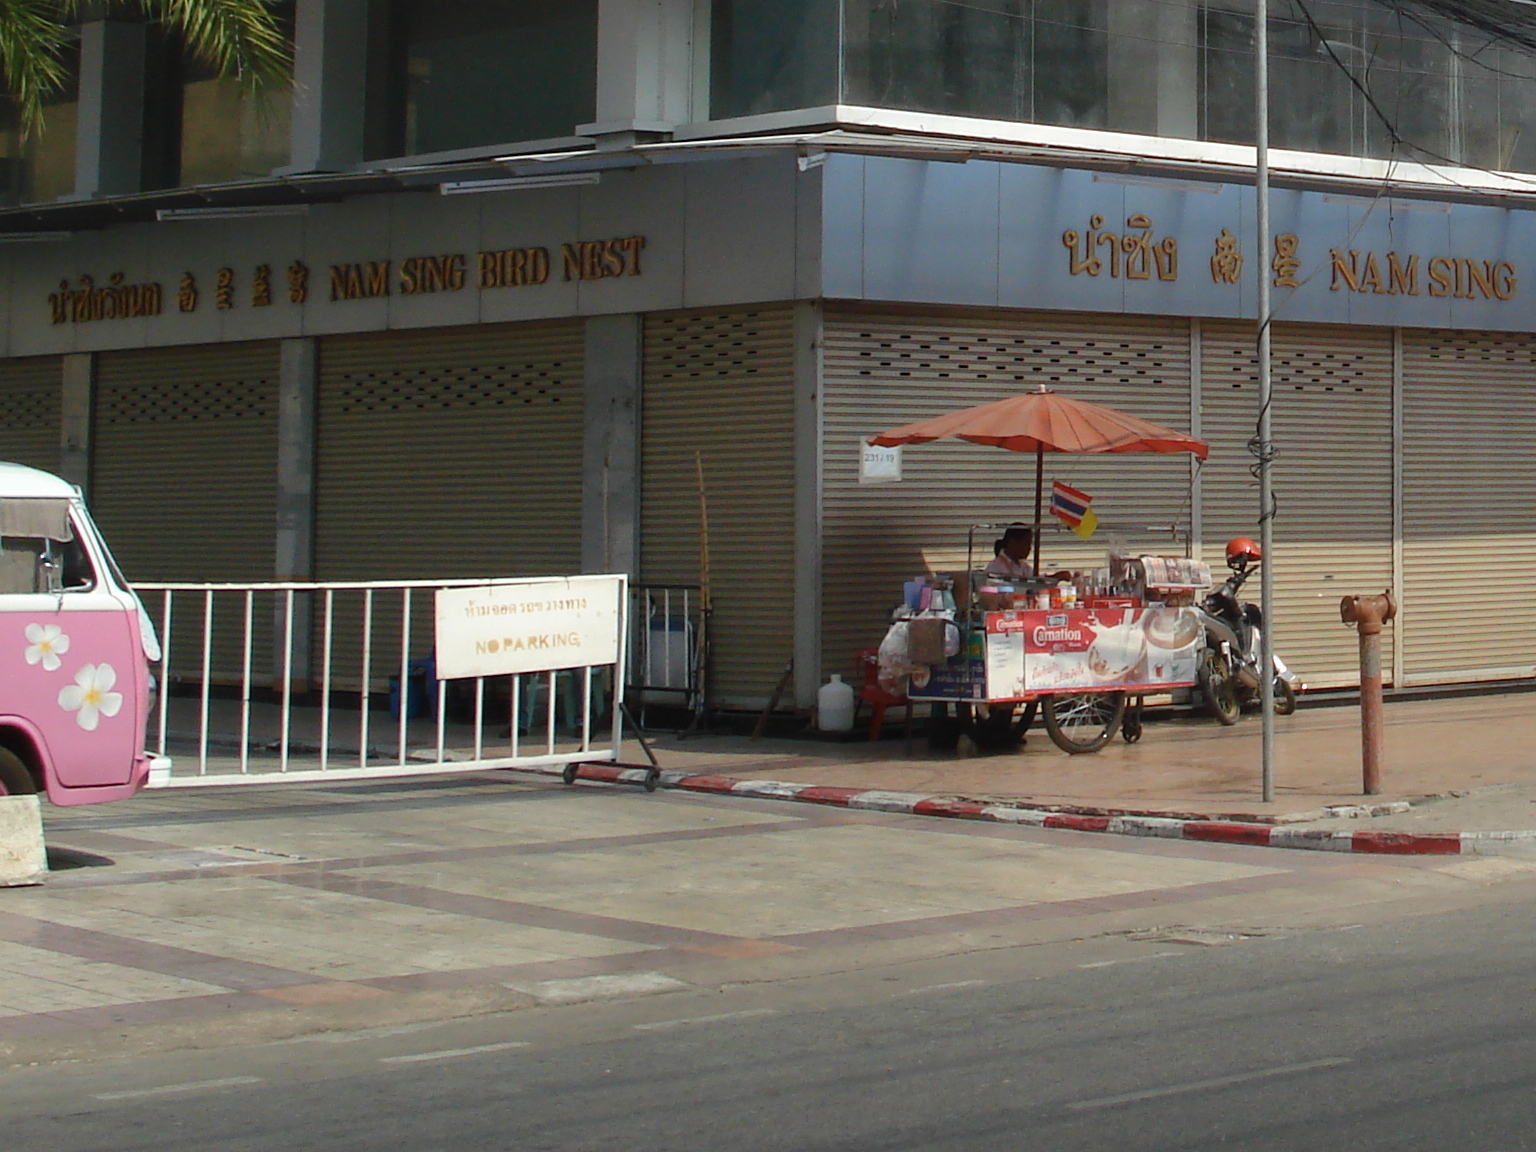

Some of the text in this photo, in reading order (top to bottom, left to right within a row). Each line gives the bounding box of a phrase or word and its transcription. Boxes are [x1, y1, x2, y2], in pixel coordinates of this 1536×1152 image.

[329, 259, 391, 301] NAM
[399, 253, 467, 295] SING
[477, 245, 551, 289] BIRD
[562, 236, 647, 282] NEST
[1063, 214, 1178, 281] นำซิง
[1330, 248, 1421, 296] NAM
[1428, 256, 1518, 300] SING
[476, 632, 580, 655] NO PARKING
[1033, 625, 1082, 647] Carnation
